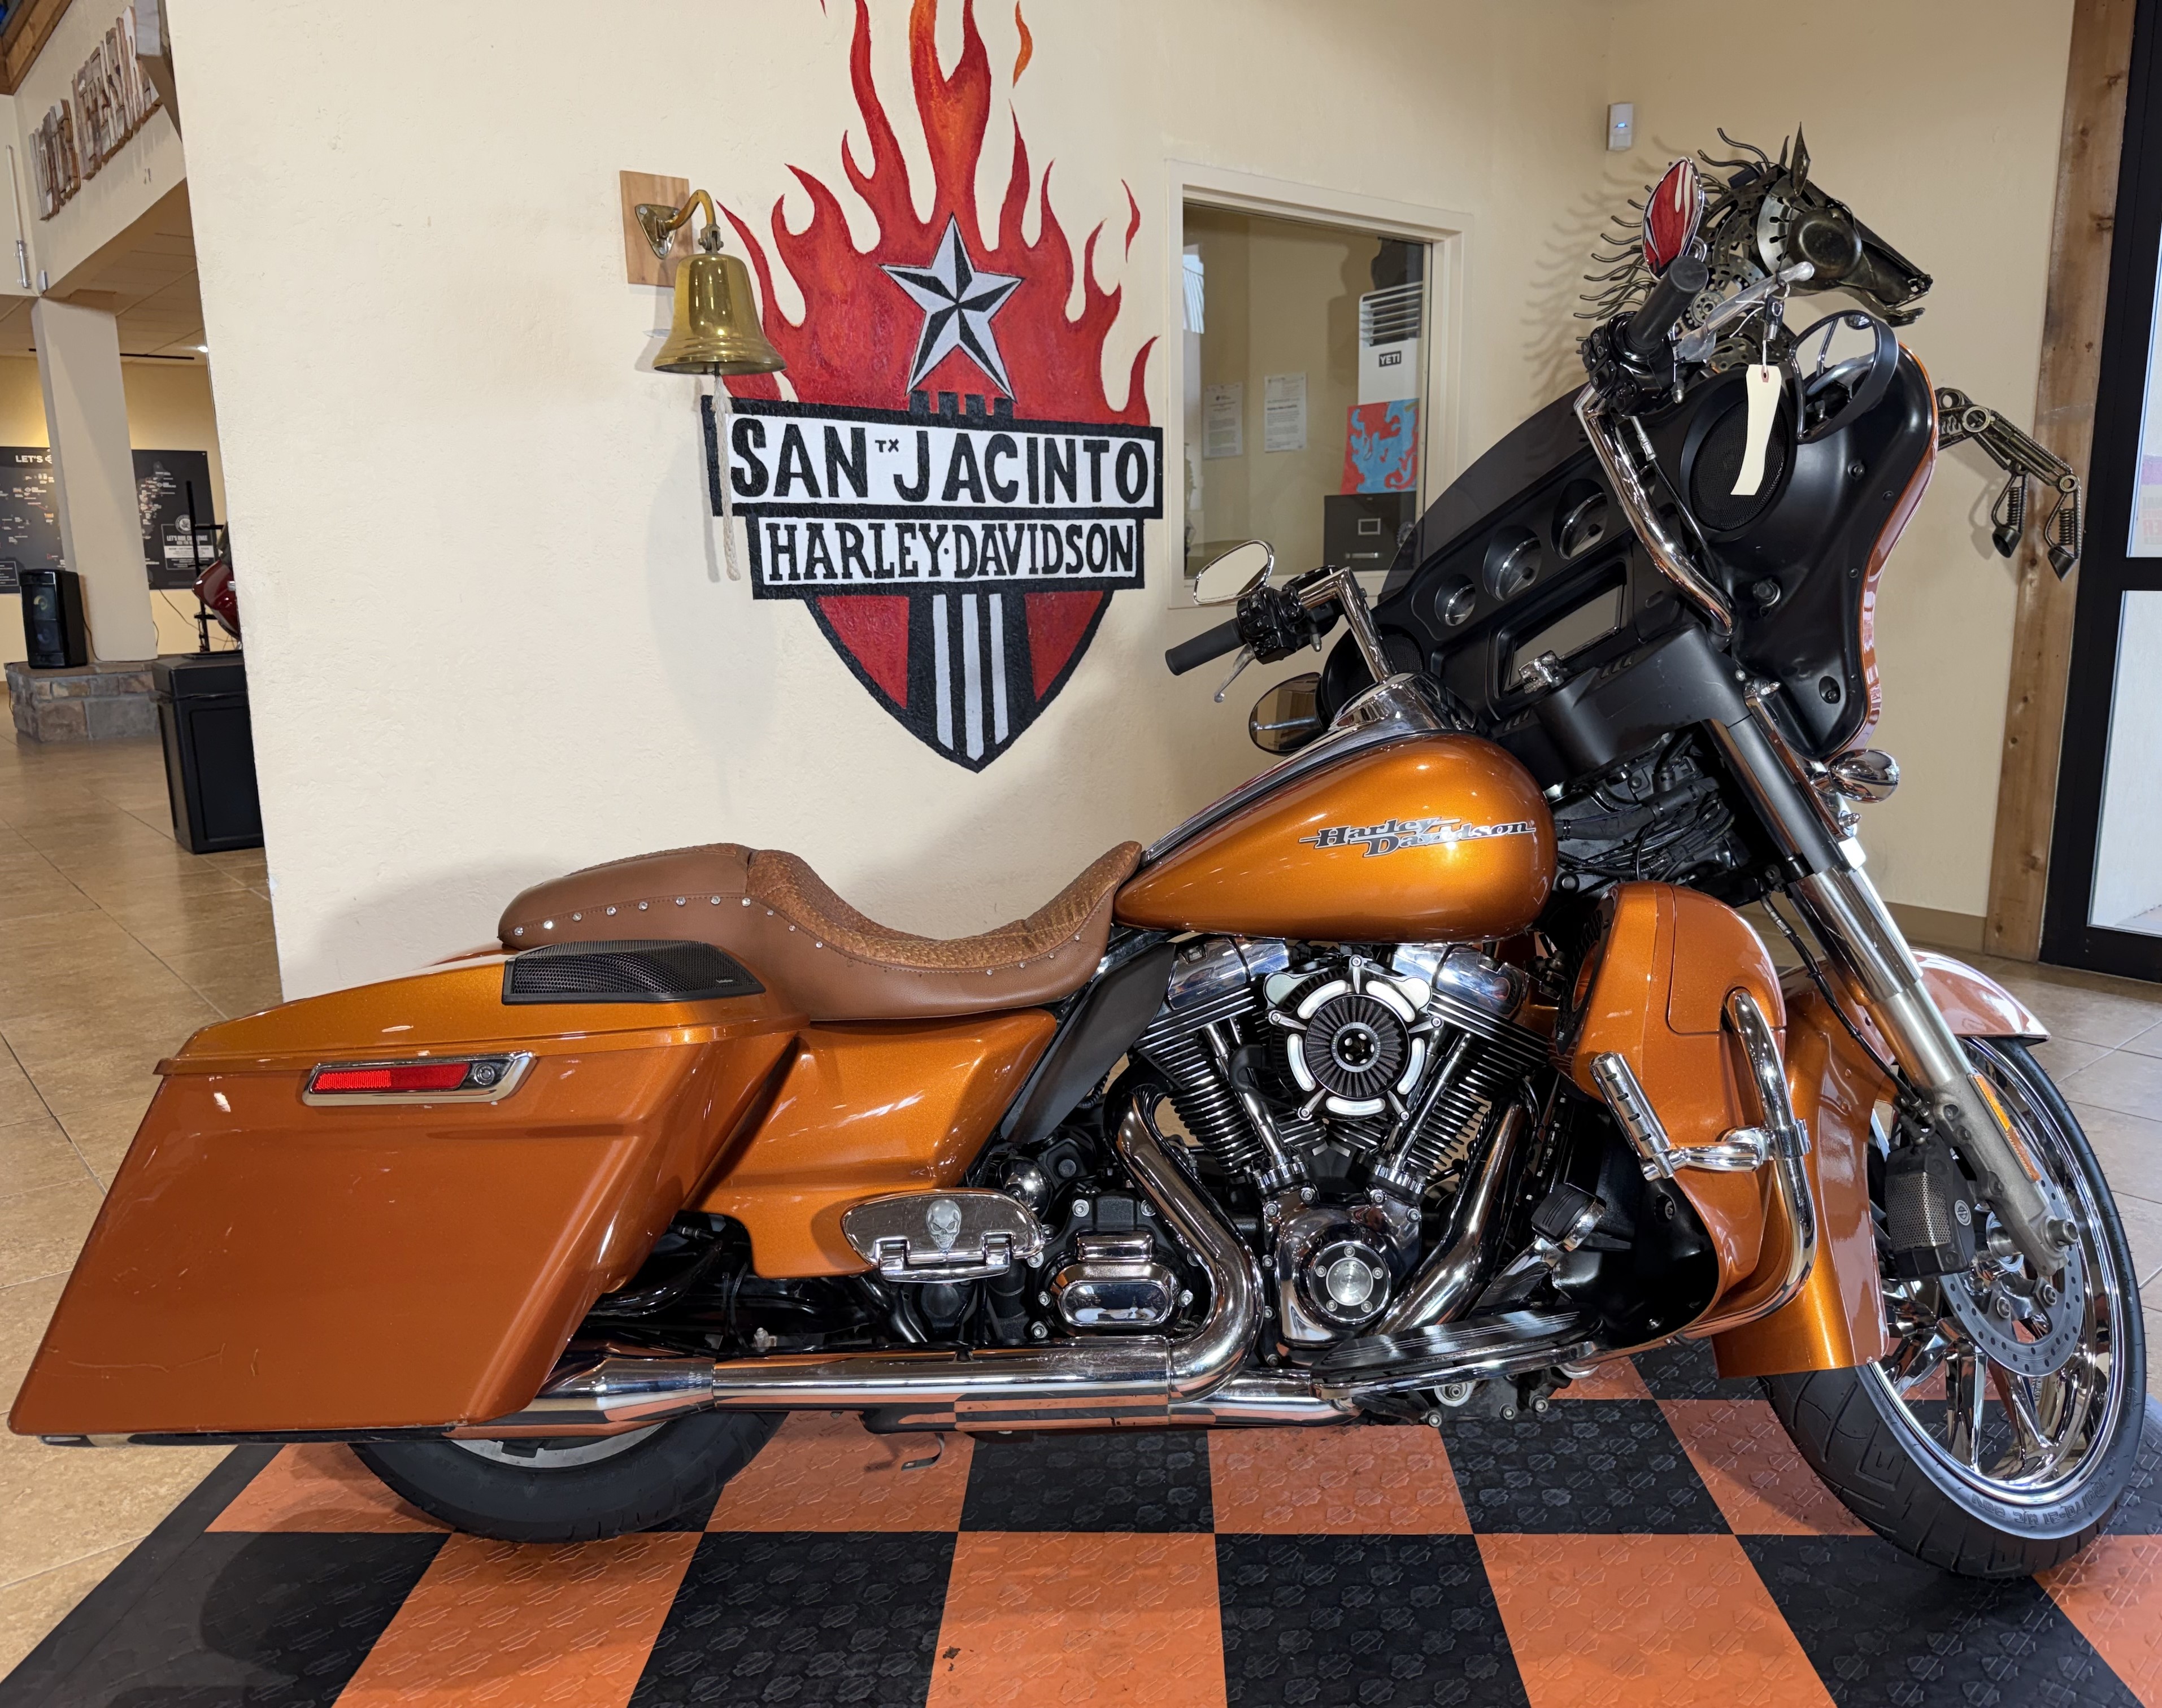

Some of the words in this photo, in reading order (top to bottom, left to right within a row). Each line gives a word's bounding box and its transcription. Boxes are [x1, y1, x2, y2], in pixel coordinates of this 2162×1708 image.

[1380, 354, 1400, 365] YETI
[15, 455, 43, 463] LET'S
[731, 418, 868, 498] SAN
[875, 439, 899, 452] TX
[894, 431, 1149, 504] JACINTO
[1299, 817, 1461, 849] Harley
[1362, 822, 1536, 857] Davidson
